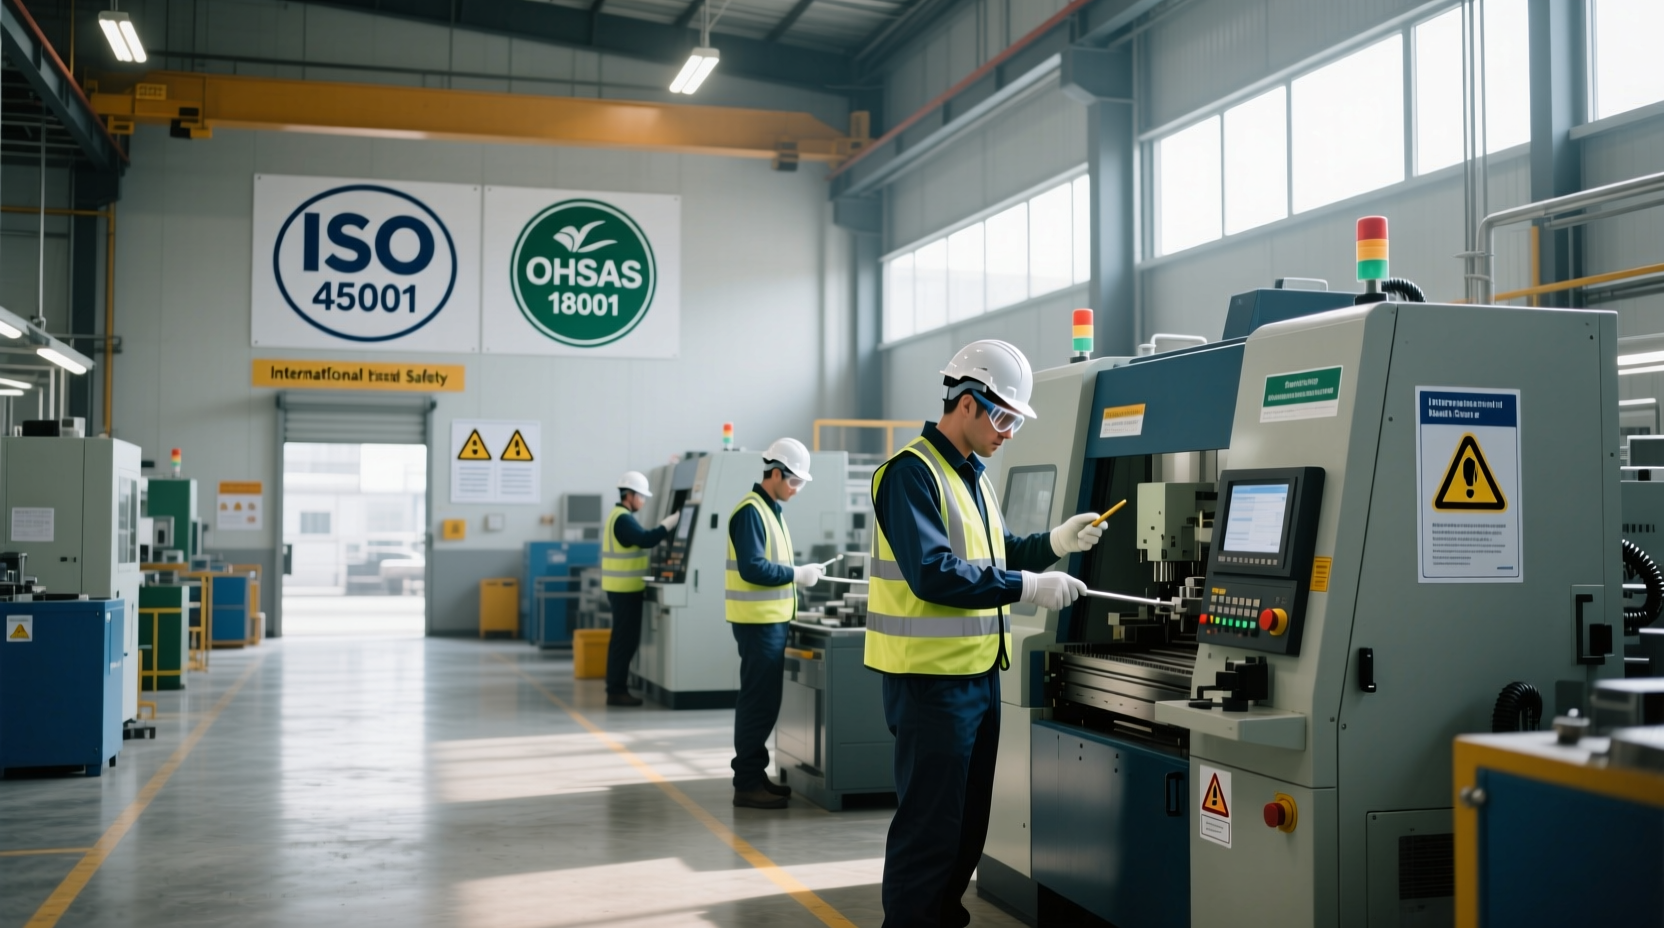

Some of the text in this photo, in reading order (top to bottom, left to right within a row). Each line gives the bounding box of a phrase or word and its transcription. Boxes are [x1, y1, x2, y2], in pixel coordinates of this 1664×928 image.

[303, 211, 435, 276] ISO
[525, 255, 643, 290] OHSAS
[311, 281, 416, 314] 45001
[548, 291, 619, 317] 18001
